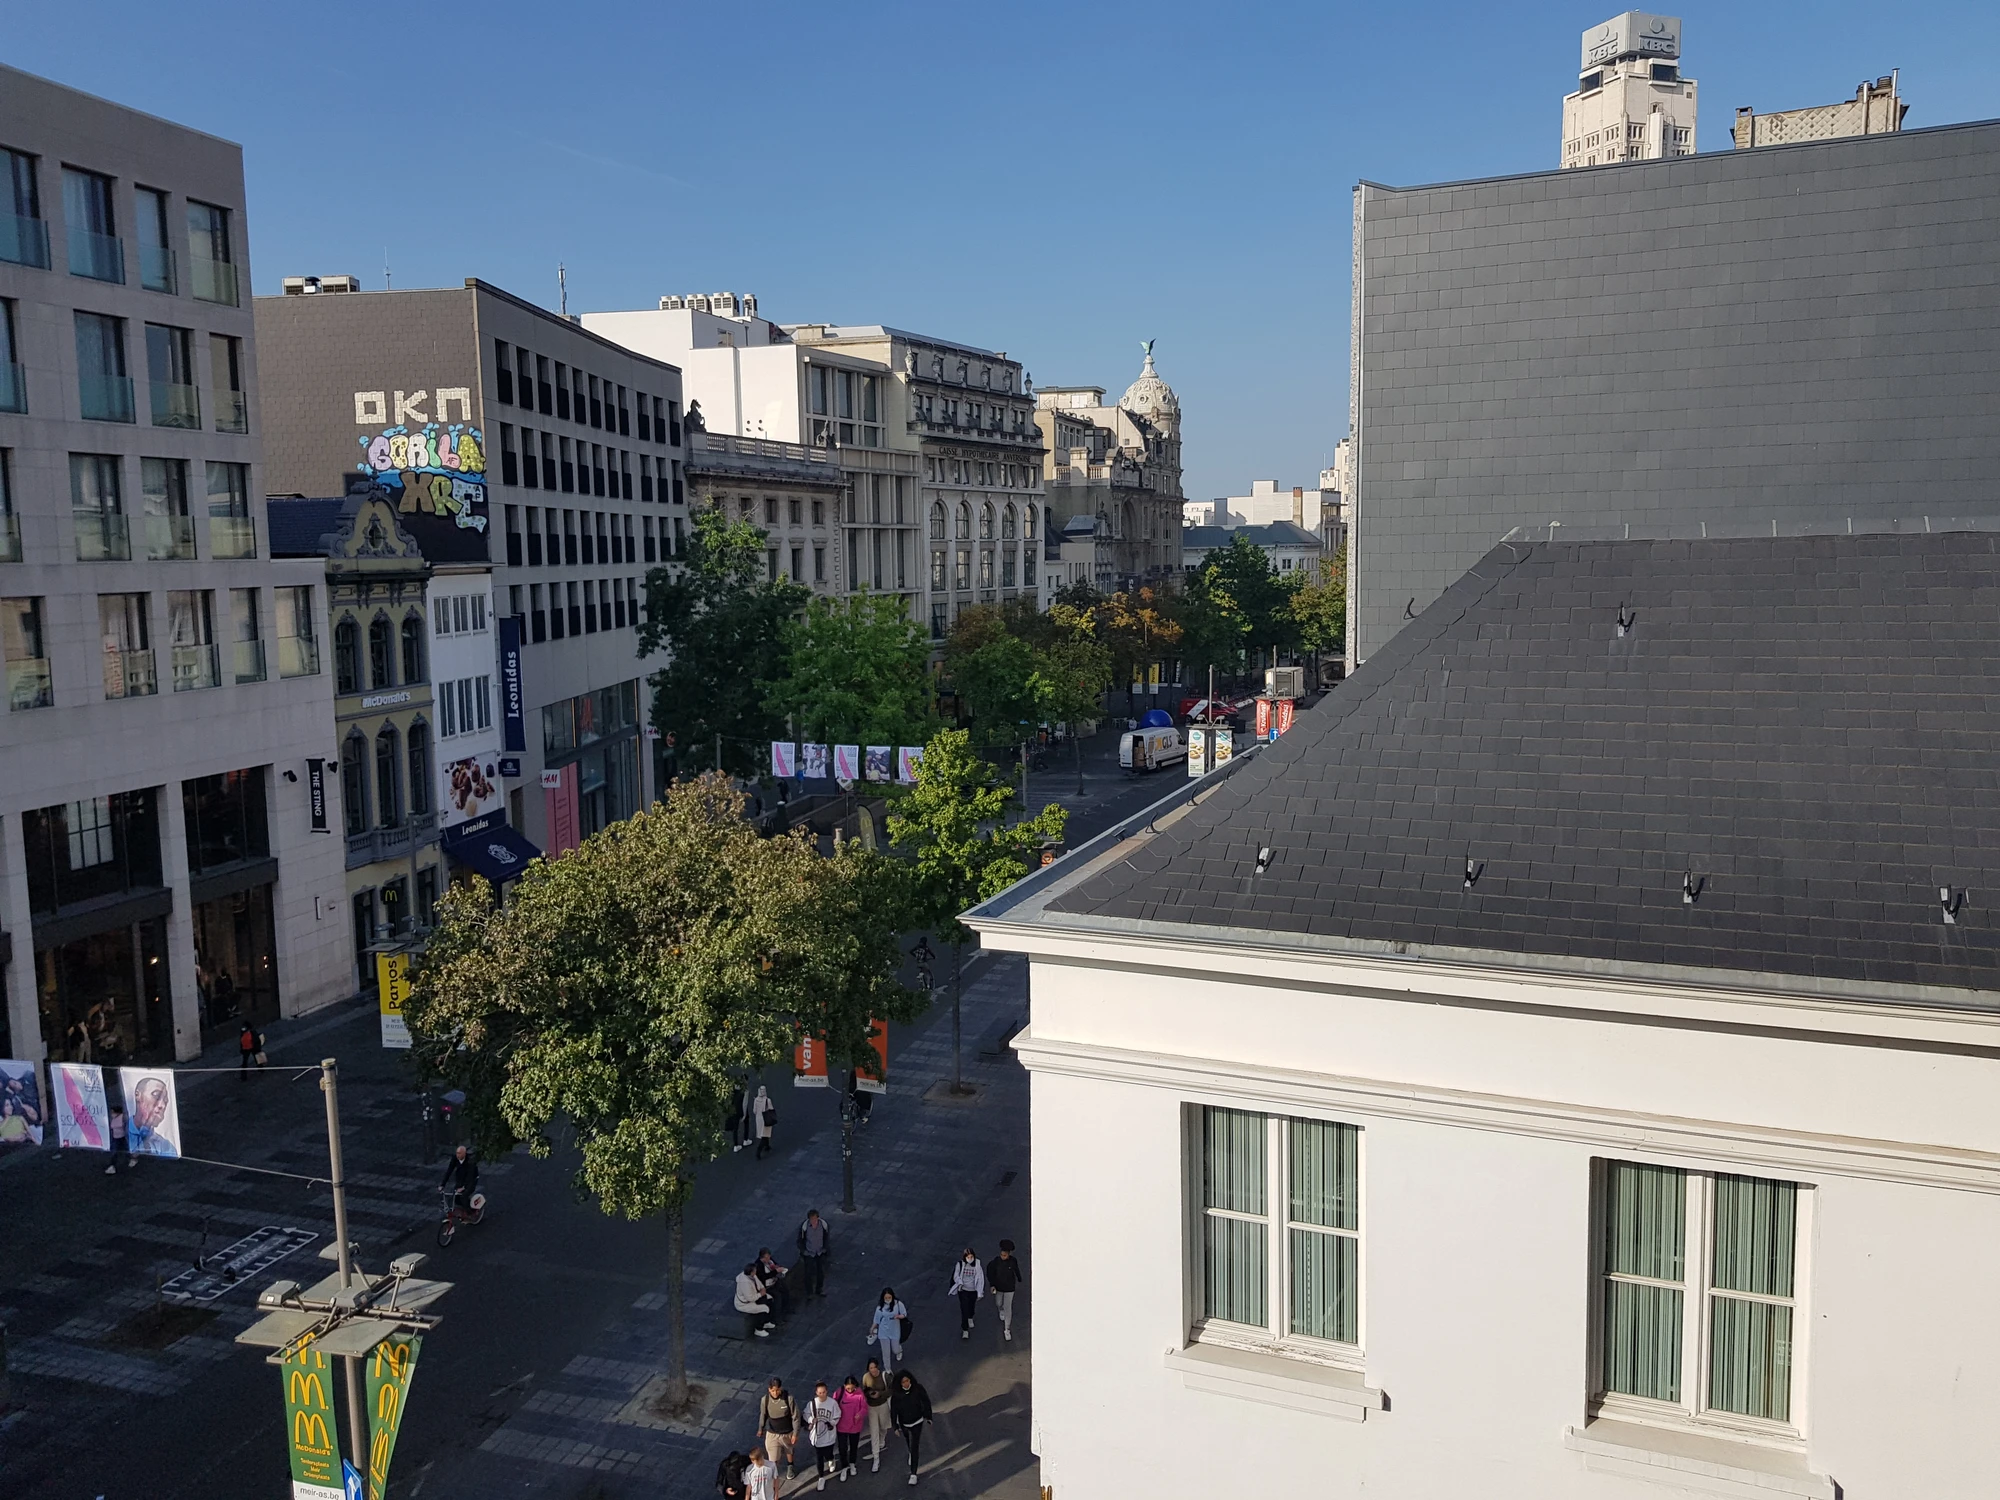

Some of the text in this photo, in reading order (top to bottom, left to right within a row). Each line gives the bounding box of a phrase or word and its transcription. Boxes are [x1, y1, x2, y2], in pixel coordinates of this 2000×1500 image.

[1588, 42, 1618, 64] KBC
[1639, 38, 1675, 54] KBC
[939, 446, 958, 456] CAISSE
[504, 651, 519, 718] Leonidas
[362, 691, 411, 708] McDonald's
[1162, 735, 1173, 750] GLS
[312, 770, 322, 817] THE STING
[461, 819, 489, 836] Leonidas
[388, 960, 400, 1010] Panos
[295, 1443, 331, 1456] McDonald's
